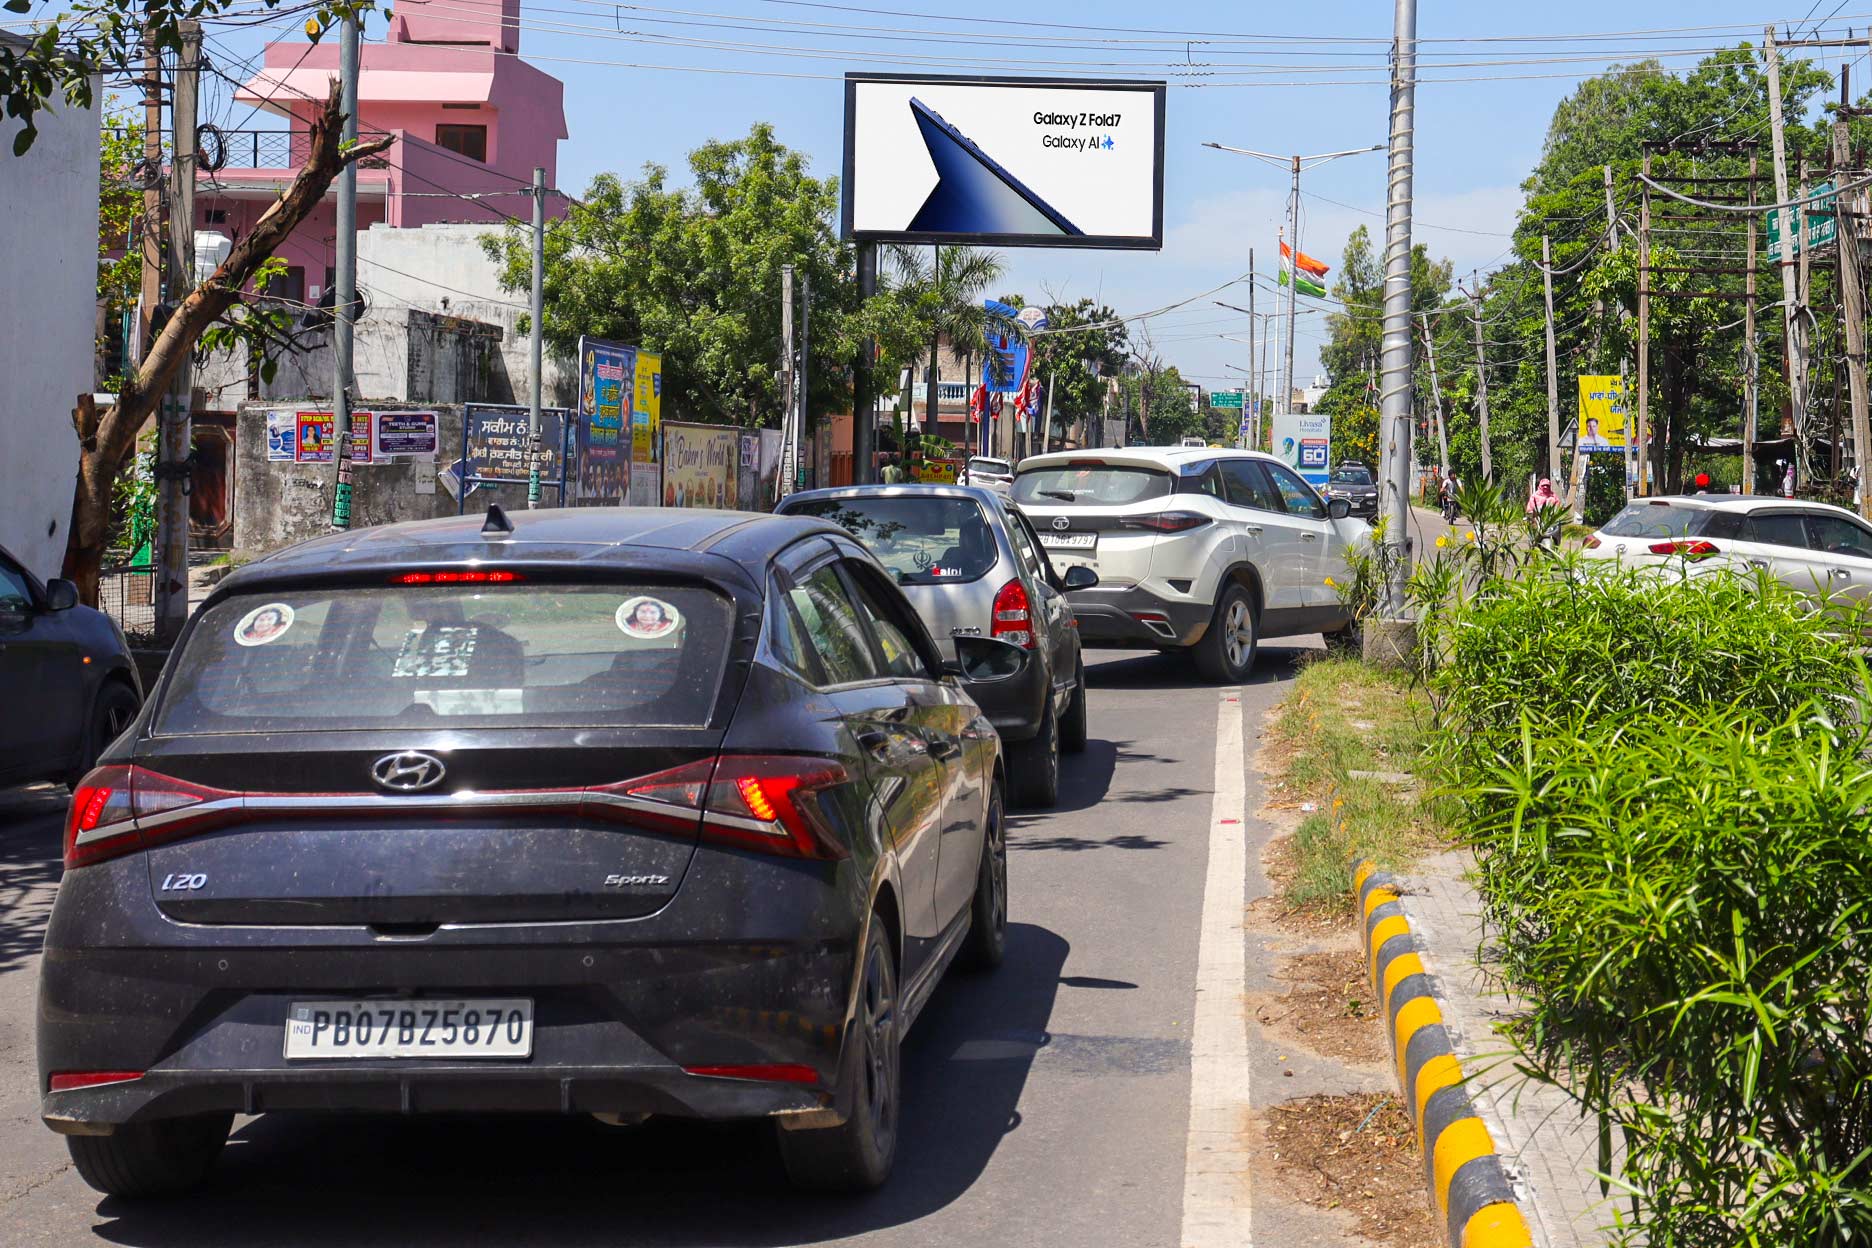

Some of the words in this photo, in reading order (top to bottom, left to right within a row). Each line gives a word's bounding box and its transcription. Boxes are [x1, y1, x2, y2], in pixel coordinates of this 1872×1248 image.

[1033, 112, 1078, 129] Galaxy
[1079, 113, 1087, 126] Z
[1089, 113, 1122, 127] Fold7
[1042, 135, 1086, 152] Galaxy
[1088, 136, 1100, 149] AI
[481, 417, 515, 434] ਸਕੀਮ
[706, 437, 725, 467] World
[1303, 448, 1326, 462] 60
[604, 874, 670, 888] Sportz
[293, 1024, 312, 1036] IND
[311, 1009, 523, 1047] PB07BZ5870
